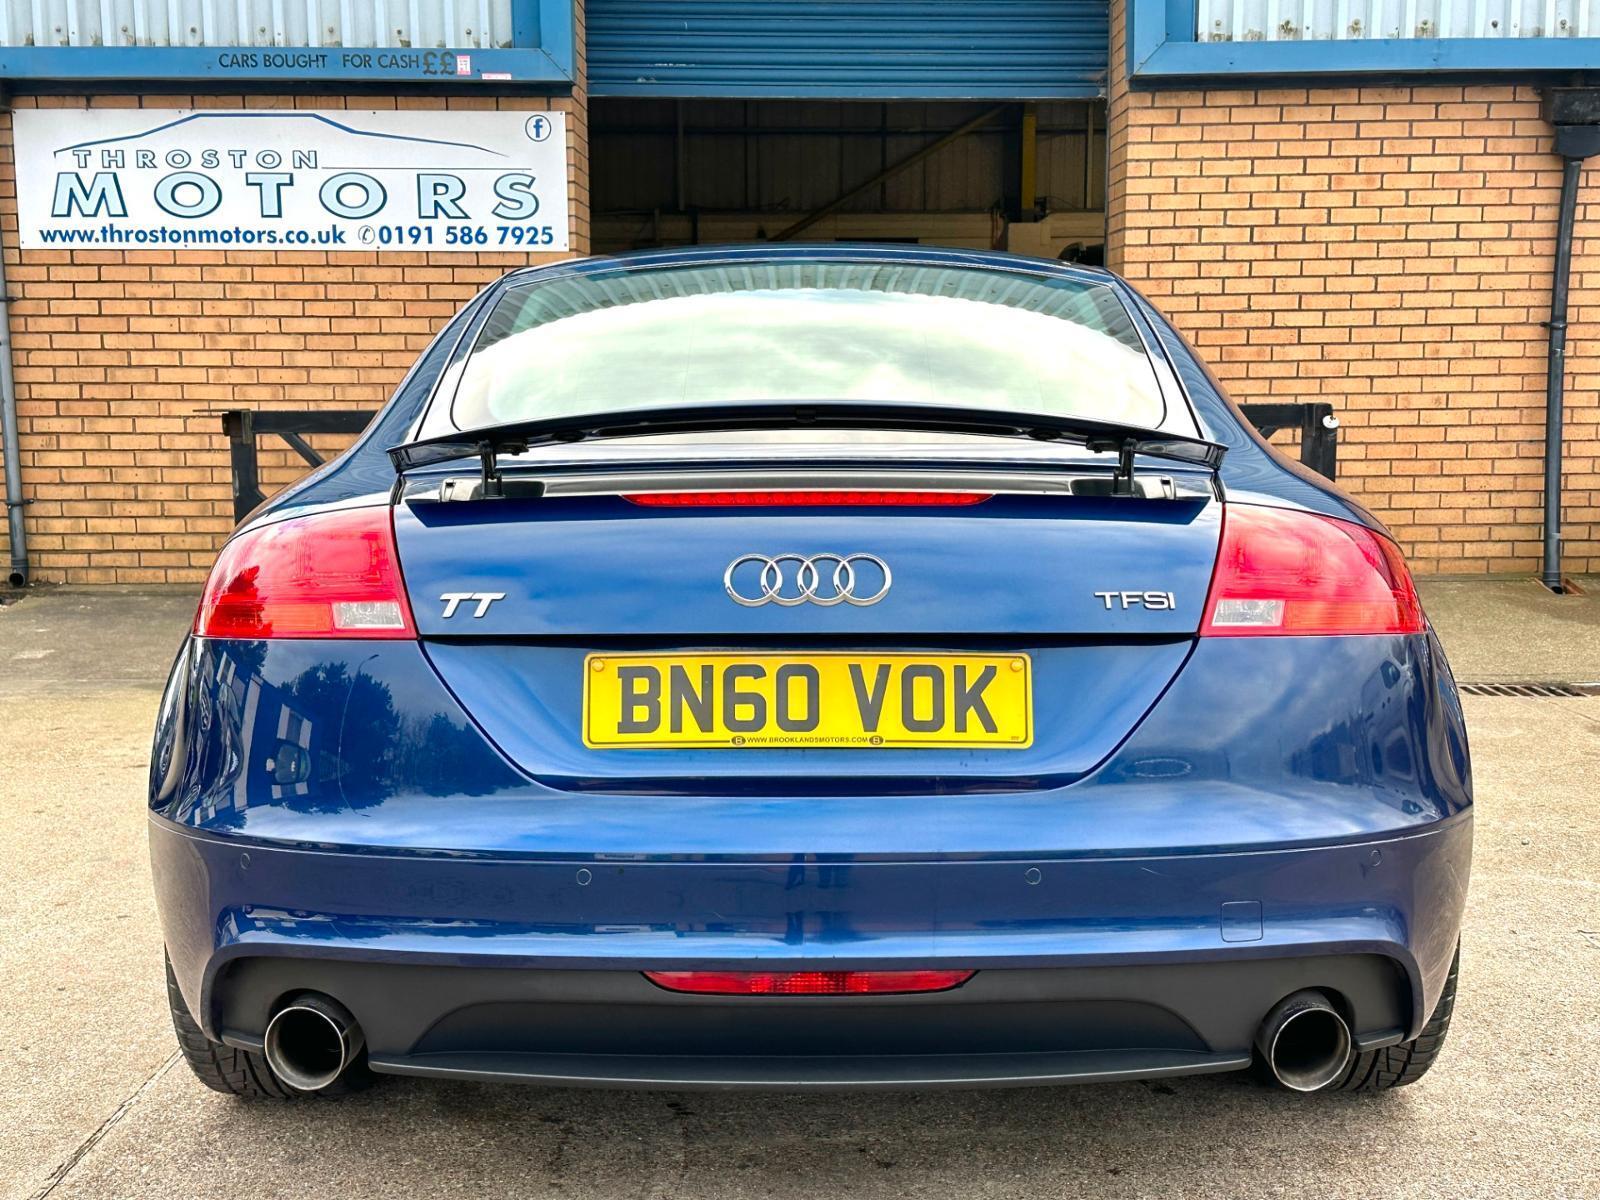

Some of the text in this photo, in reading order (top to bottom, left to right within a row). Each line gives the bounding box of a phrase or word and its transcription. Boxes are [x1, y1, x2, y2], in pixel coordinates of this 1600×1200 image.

[218, 53, 258, 69] CARS
[263, 53, 328, 69] BOUGHT
[342, 53, 372, 69] FOR
[73, 149, 318, 169] THROSTON
[51, 171, 540, 221] MOTORS
[39, 223, 554, 245] www.throstonmotors.co.uk 0191 586 7925
[439, 592, 507, 619] TT
[1094, 591, 1176, 610] TFSI
[617, 664, 998, 733] BN60 VOK
